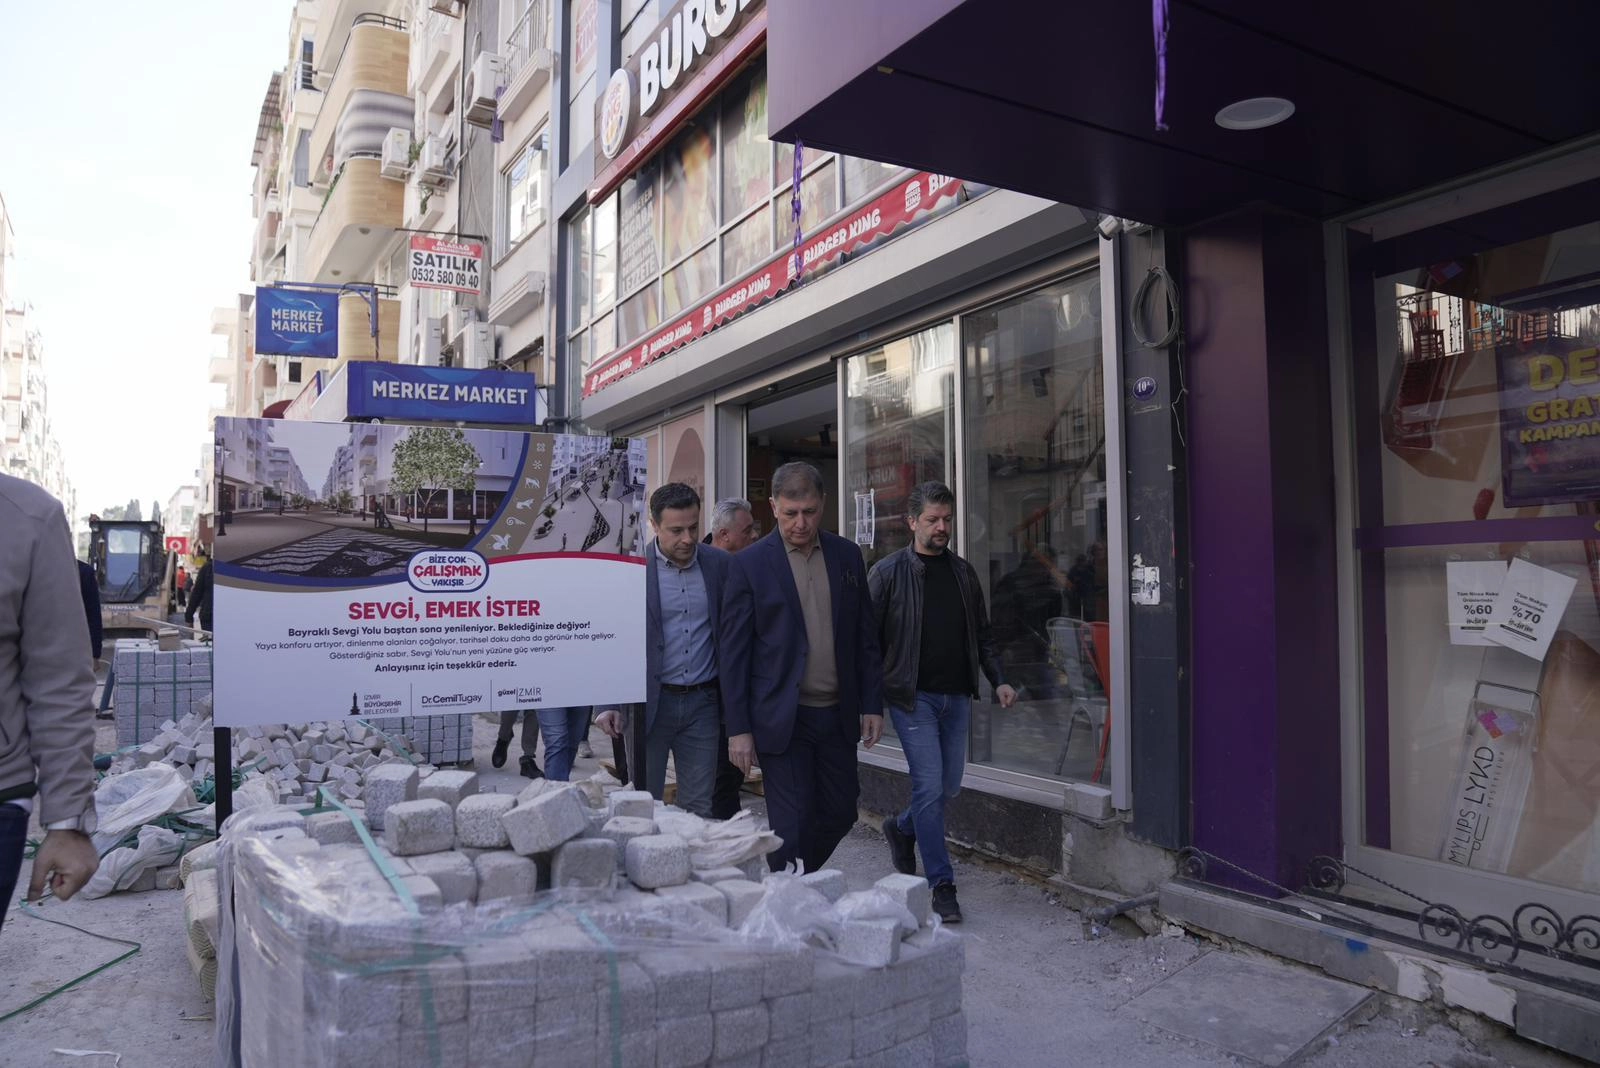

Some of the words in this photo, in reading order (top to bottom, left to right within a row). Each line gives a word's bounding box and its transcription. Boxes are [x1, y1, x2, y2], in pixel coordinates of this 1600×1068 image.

[640, 0, 754, 117] BURG
[928, 174, 954, 197] BU
[802, 228, 848, 267] BURGER
[848, 207, 881, 240] KING
[412, 251, 478, 273] SATILIK
[411, 267, 434, 282] 0532
[437, 270, 453, 285] 580
[456, 272, 466, 287] 09
[468, 274, 479, 289] 40
[714, 287, 747, 318] BURGER
[746, 273, 771, 300] KING
[271, 308, 323, 322] MERKEZ
[271, 319, 323, 334] MARKET
[372, 380, 450, 401] MERKEZ
[454, 385, 528, 405] MARKET
[428, 554, 447, 564] BİZE
[447, 555, 467, 565] ÇOK
[413, 565, 482, 578] ÇALIŞMAK
[431, 578, 464, 588] YAKIŞIR
[348, 597, 420, 621] SEVGİ,
[426, 600, 481, 619] EMEK
[486, 596, 541, 617] İSTER
[1463, 604, 1493, 615] %60
[1512, 605, 1541, 624] %70
[288, 627, 330, 639] Bayraklı
[332, 627, 360, 638] Sevgi
[361, 626, 381, 635] Yolu
[383, 626, 418, 636] baştan
[419, 626, 442, 634] sona
[444, 624, 496, 635] yenileniyor.
[498, 622, 555, 632] Beklediğinize
[556, 621, 591, 632] değiyor!
[255, 642, 277, 652] Yaya
[279, 641, 312, 649] konforu
[346, 639, 384, 647] dinlenme
[386, 638, 418, 646] alanları
[459, 635, 489, 644] tarihsel
[490, 635, 509, 643] doku
[510, 634, 530, 642] daha
[532, 634, 543, 642] da
[544, 633, 573, 643] görünür
[573, 632, 590, 640] hale
[591, 632, 617, 641] geliyor.
[329, 651, 384, 660] Gösterdiğiniz
[410, 649, 433, 658] Sevgi
[468, 648, 484, 657] yeni
[485, 647, 513, 656] yüzüne
[514, 646, 529, 656] güç
[530, 645, 557, 655] veriyor.
[374, 663, 426, 674] Anlayışınız
[427, 661, 444, 672] için
[446, 660, 486, 671] teşekkür
[487, 659, 517, 669] ederiz.
[1449, 808, 1476, 865] MYLIPS
